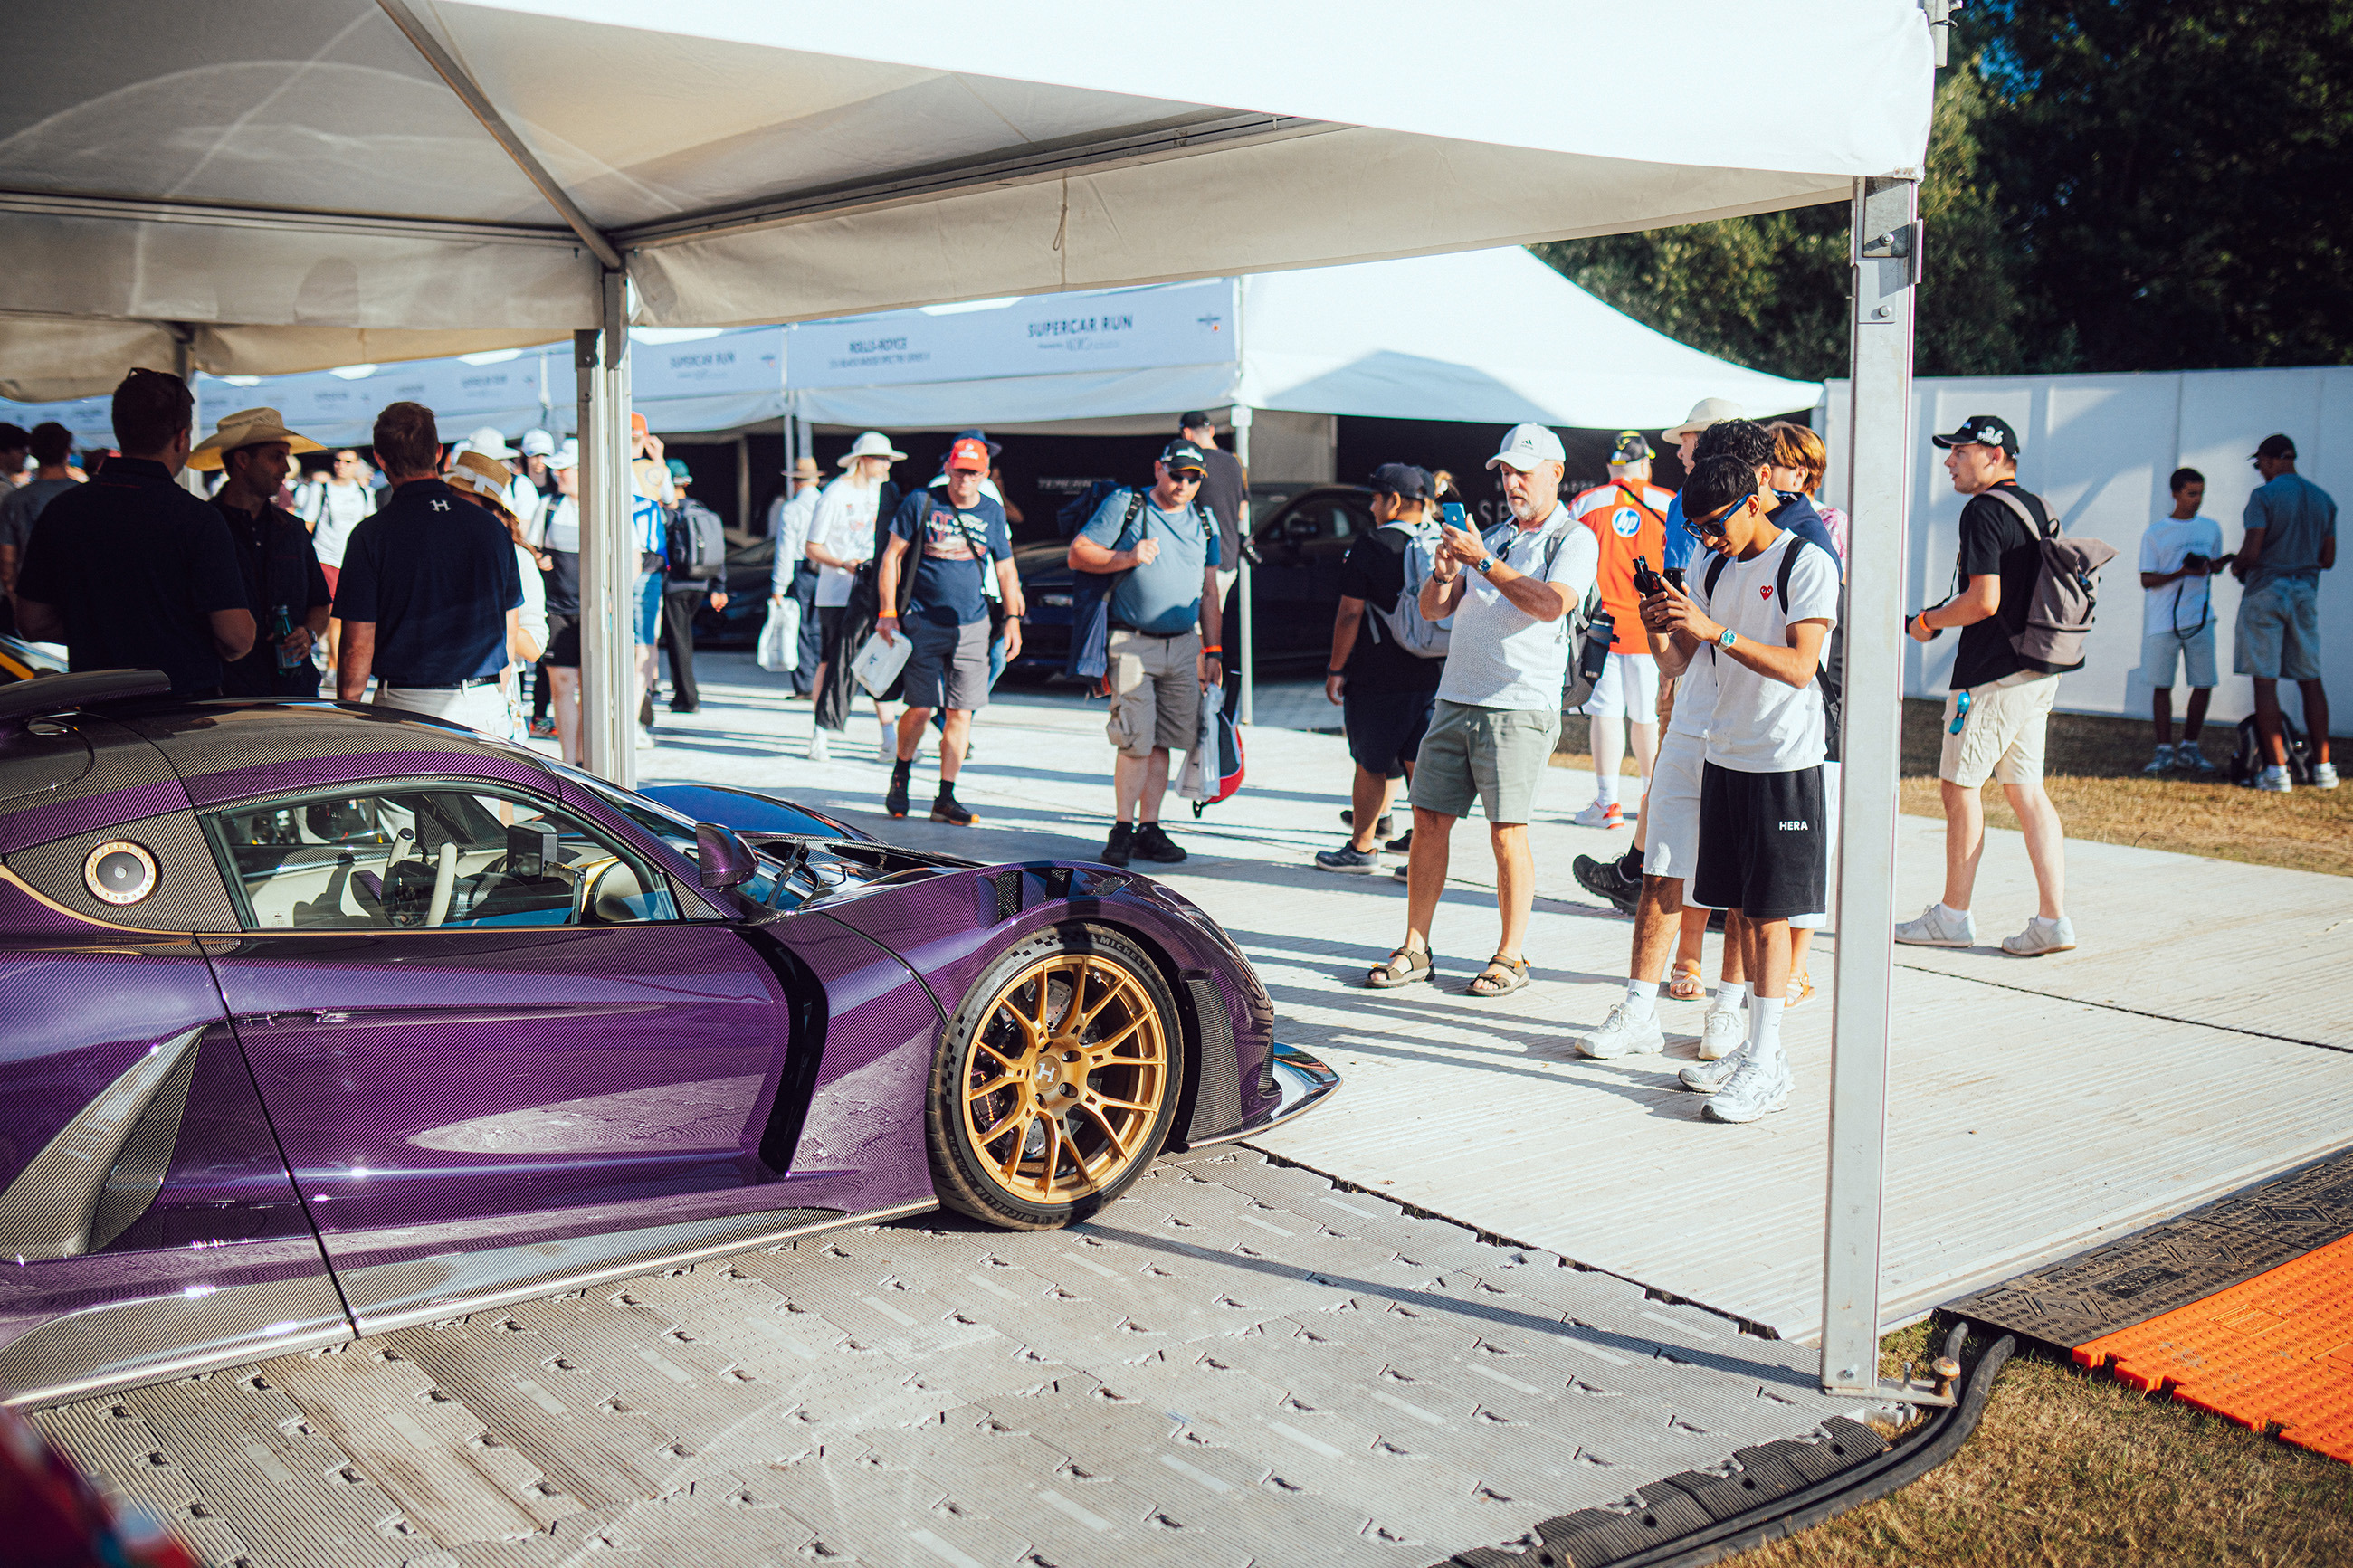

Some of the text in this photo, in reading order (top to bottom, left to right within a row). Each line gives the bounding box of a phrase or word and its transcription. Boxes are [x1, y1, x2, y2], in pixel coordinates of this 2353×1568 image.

[1028, 315, 1133, 337] SUPERCAR RUN
[1615, 508, 1639, 537] hp
[1778, 821, 1808, 831] HERA
[1100, 936, 1155, 977] MICHELIN
[974, 1185, 1035, 1222] MICHELIN
